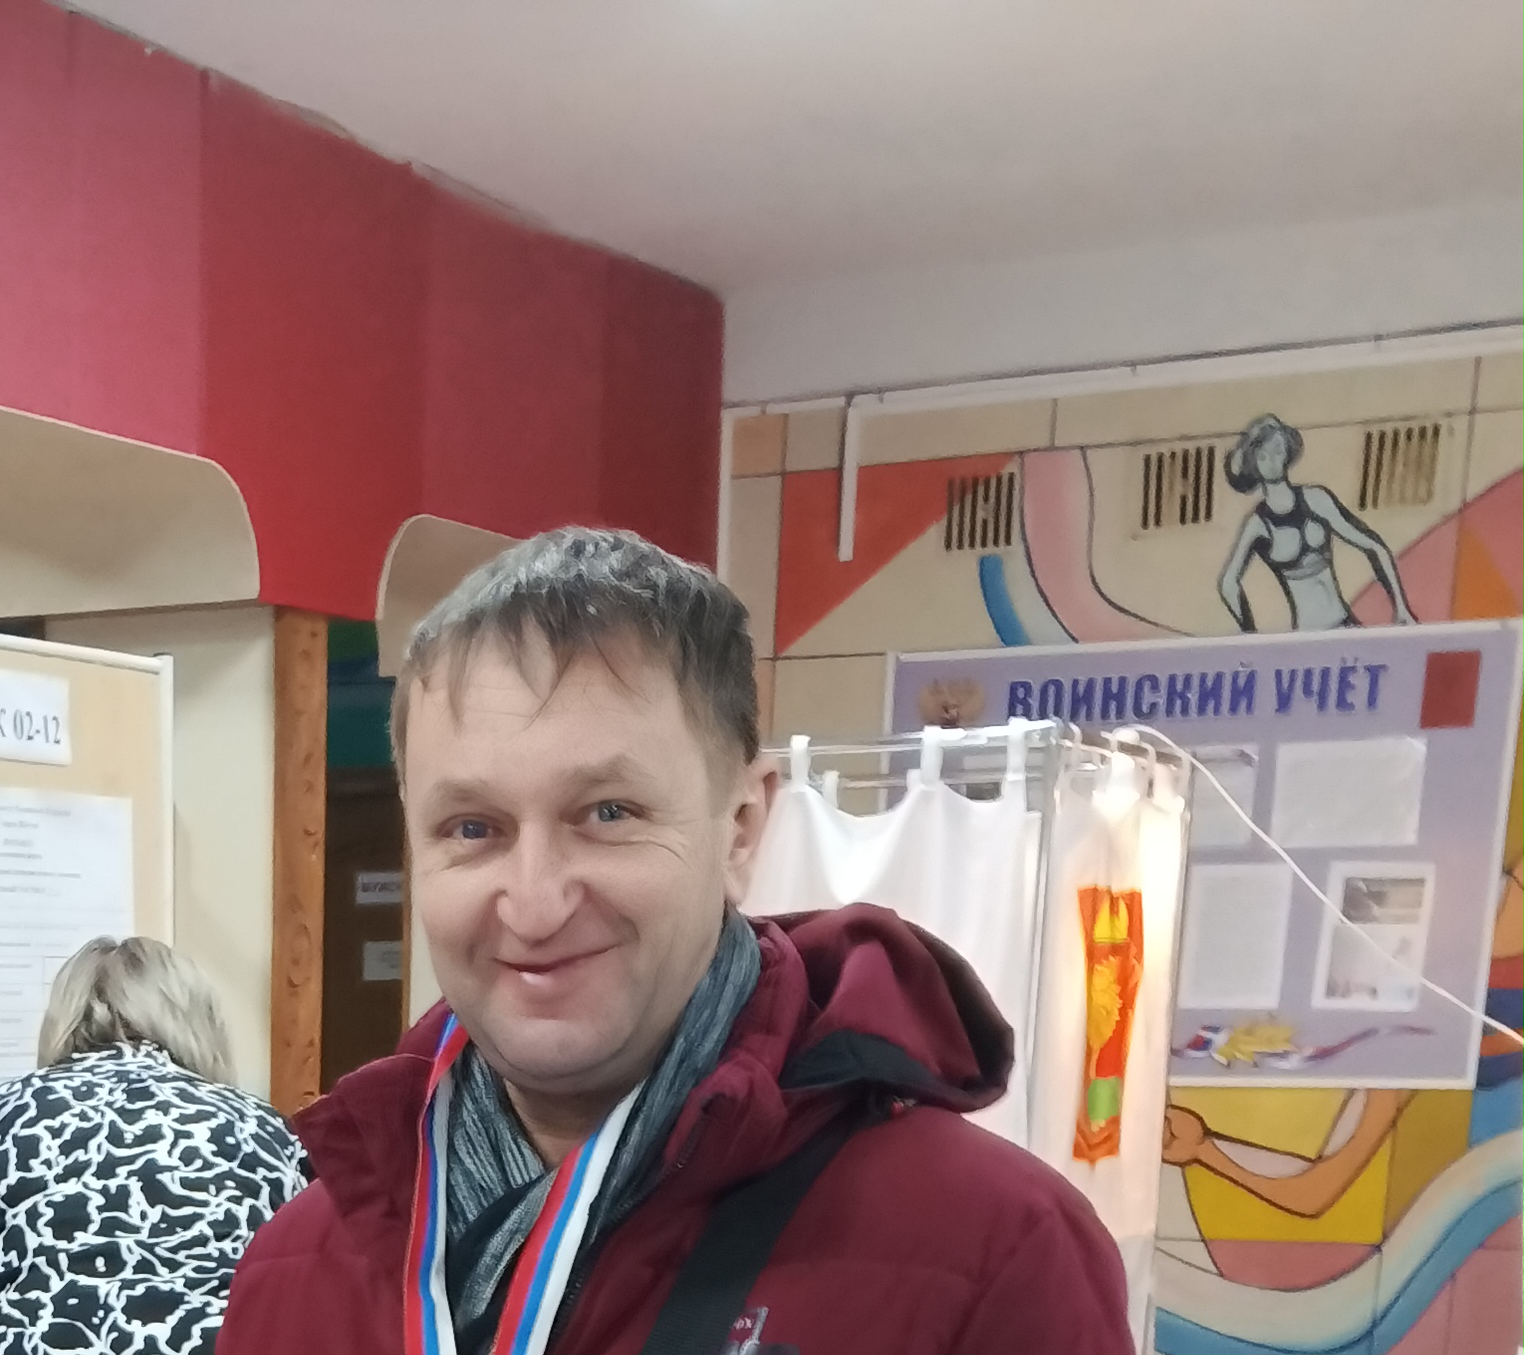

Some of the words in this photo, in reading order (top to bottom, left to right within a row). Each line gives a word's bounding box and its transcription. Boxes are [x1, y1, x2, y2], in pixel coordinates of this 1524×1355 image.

[1006, 661, 1258, 721] ВОИНСКИЙ
[1274, 655, 1390, 715] УЧЁТ
[13, 708, 62, 745] 02-12
